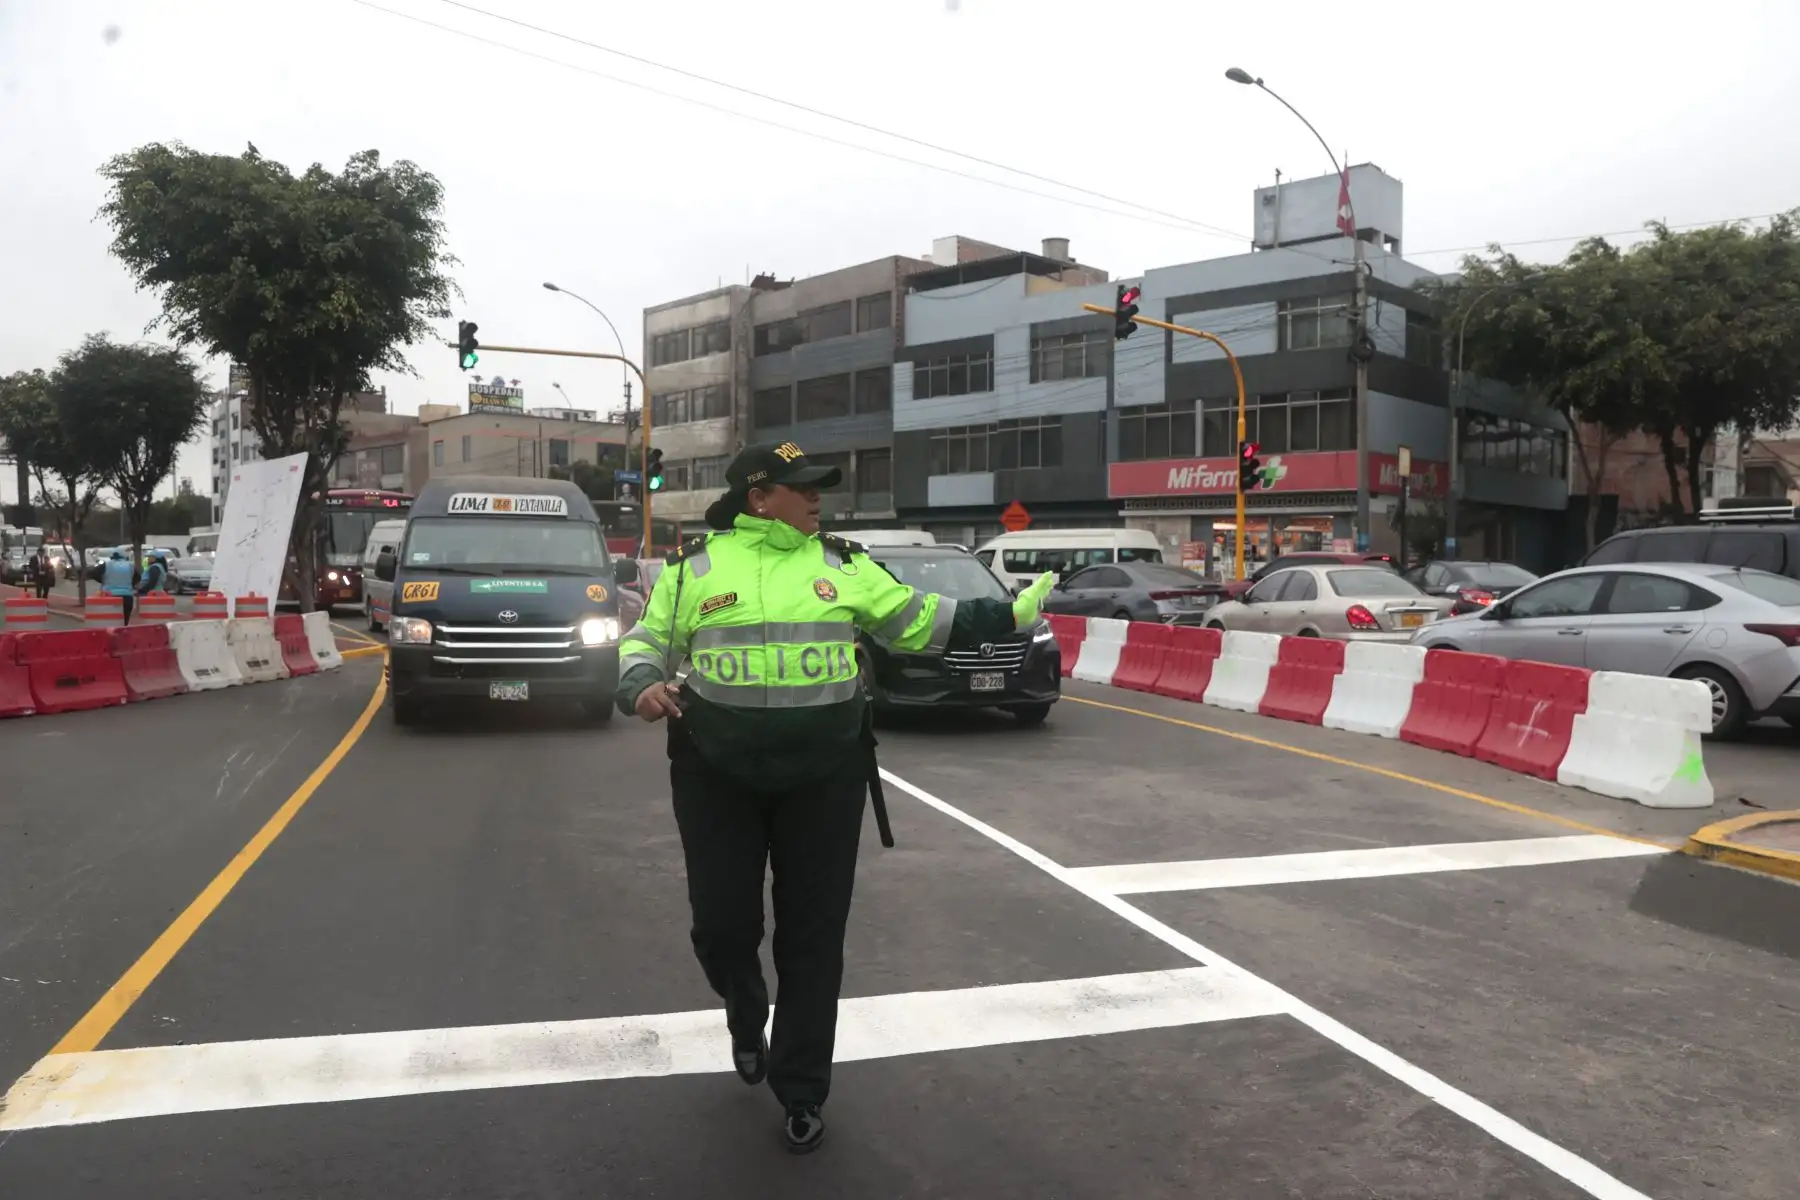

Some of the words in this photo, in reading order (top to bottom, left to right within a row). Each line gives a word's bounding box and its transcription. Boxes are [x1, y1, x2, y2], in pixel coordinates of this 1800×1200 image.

[1167, 464, 1239, 489] Mifarm
[451, 497, 488, 511] LIMA
[514, 498, 563, 512] VENTANILLA
[698, 646, 851, 682] POLICIA
